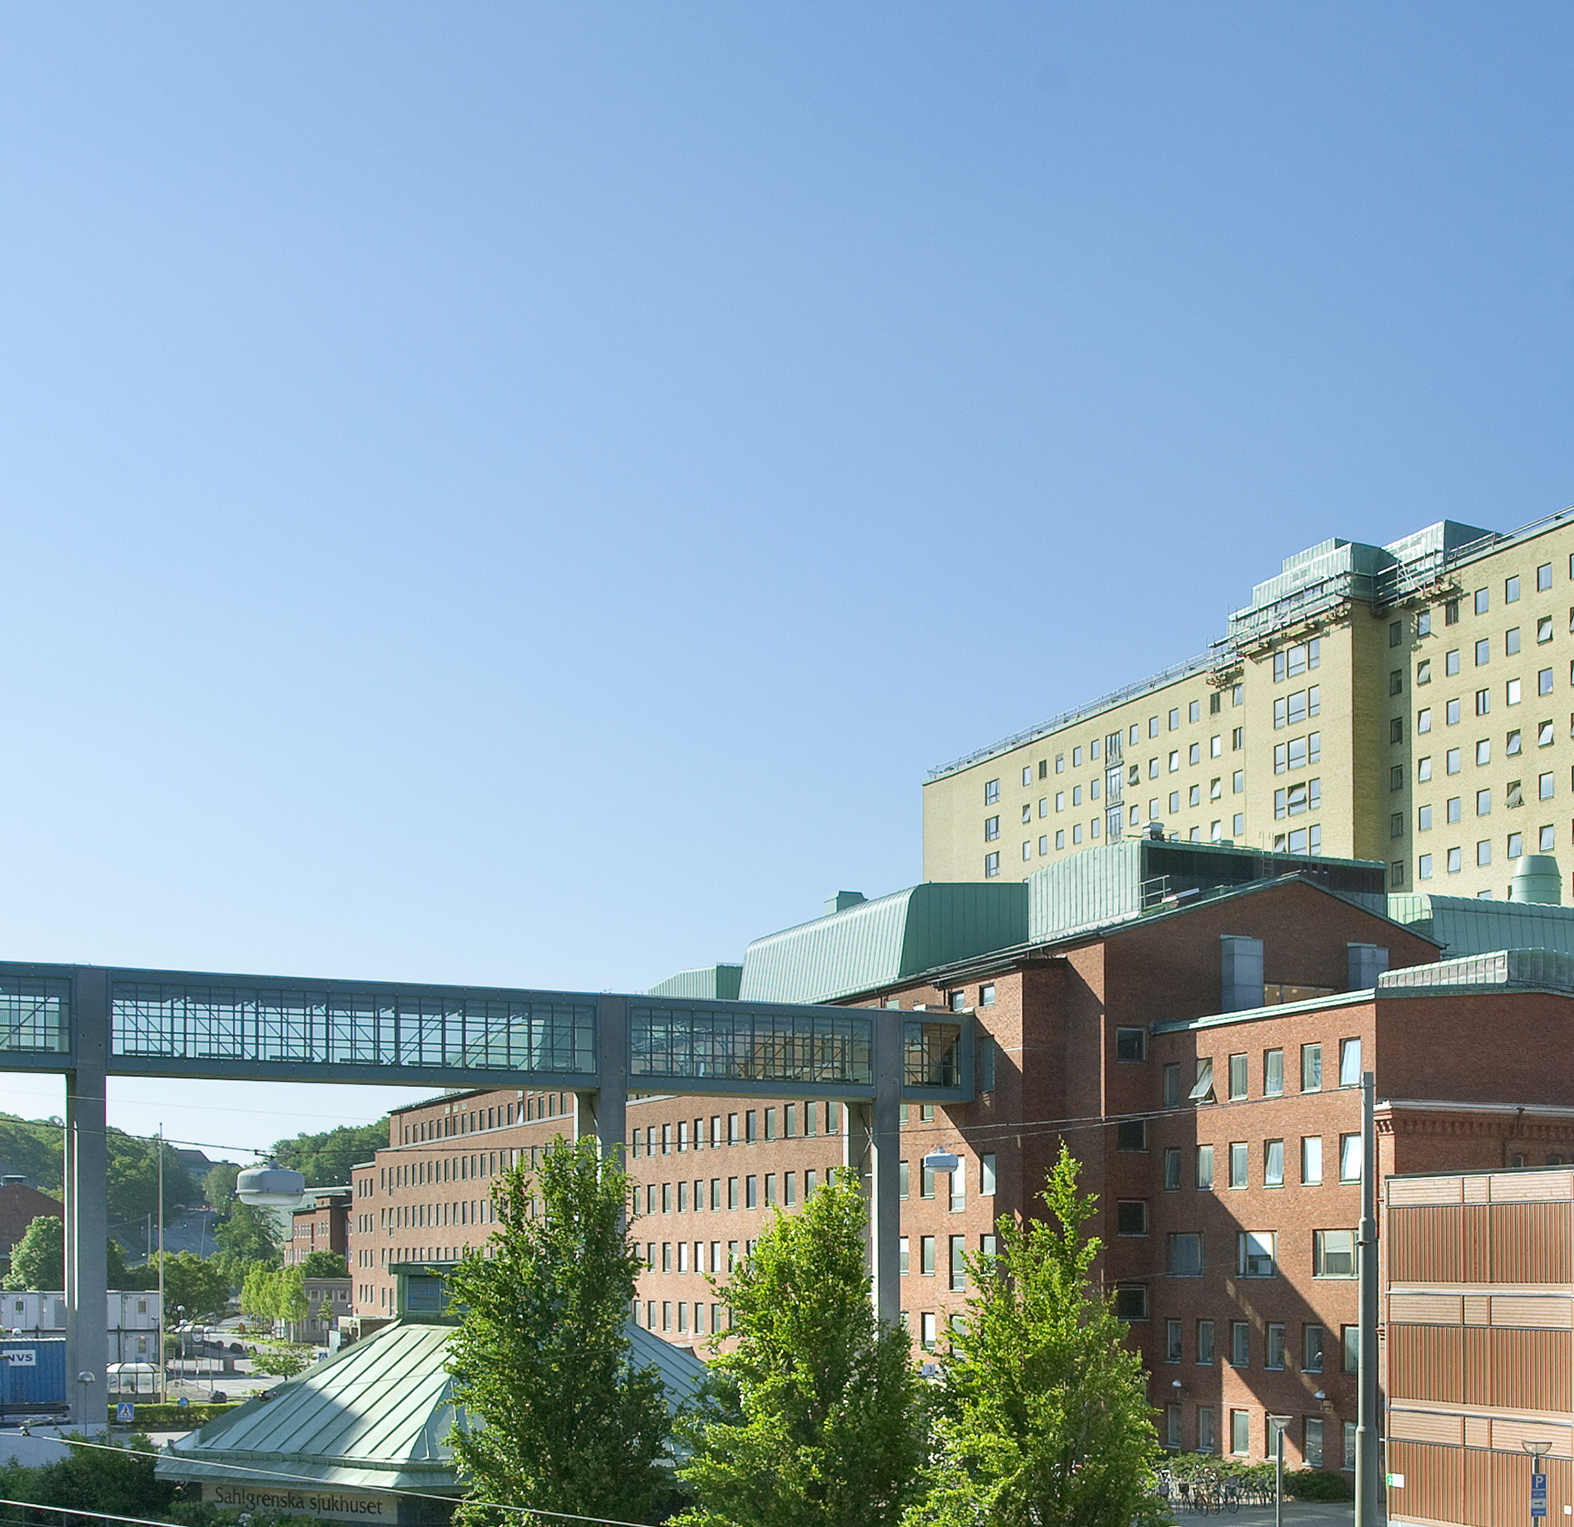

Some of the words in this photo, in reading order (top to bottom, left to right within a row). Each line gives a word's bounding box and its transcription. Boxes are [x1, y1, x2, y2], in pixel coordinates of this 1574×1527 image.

[6, 1353, 33, 1362] NVS
[1535, 1475, 1544, 1488] P
[215, 1486, 305, 1511] Sahlgrenska
[309, 1495, 383, 1515] sjukhuset
